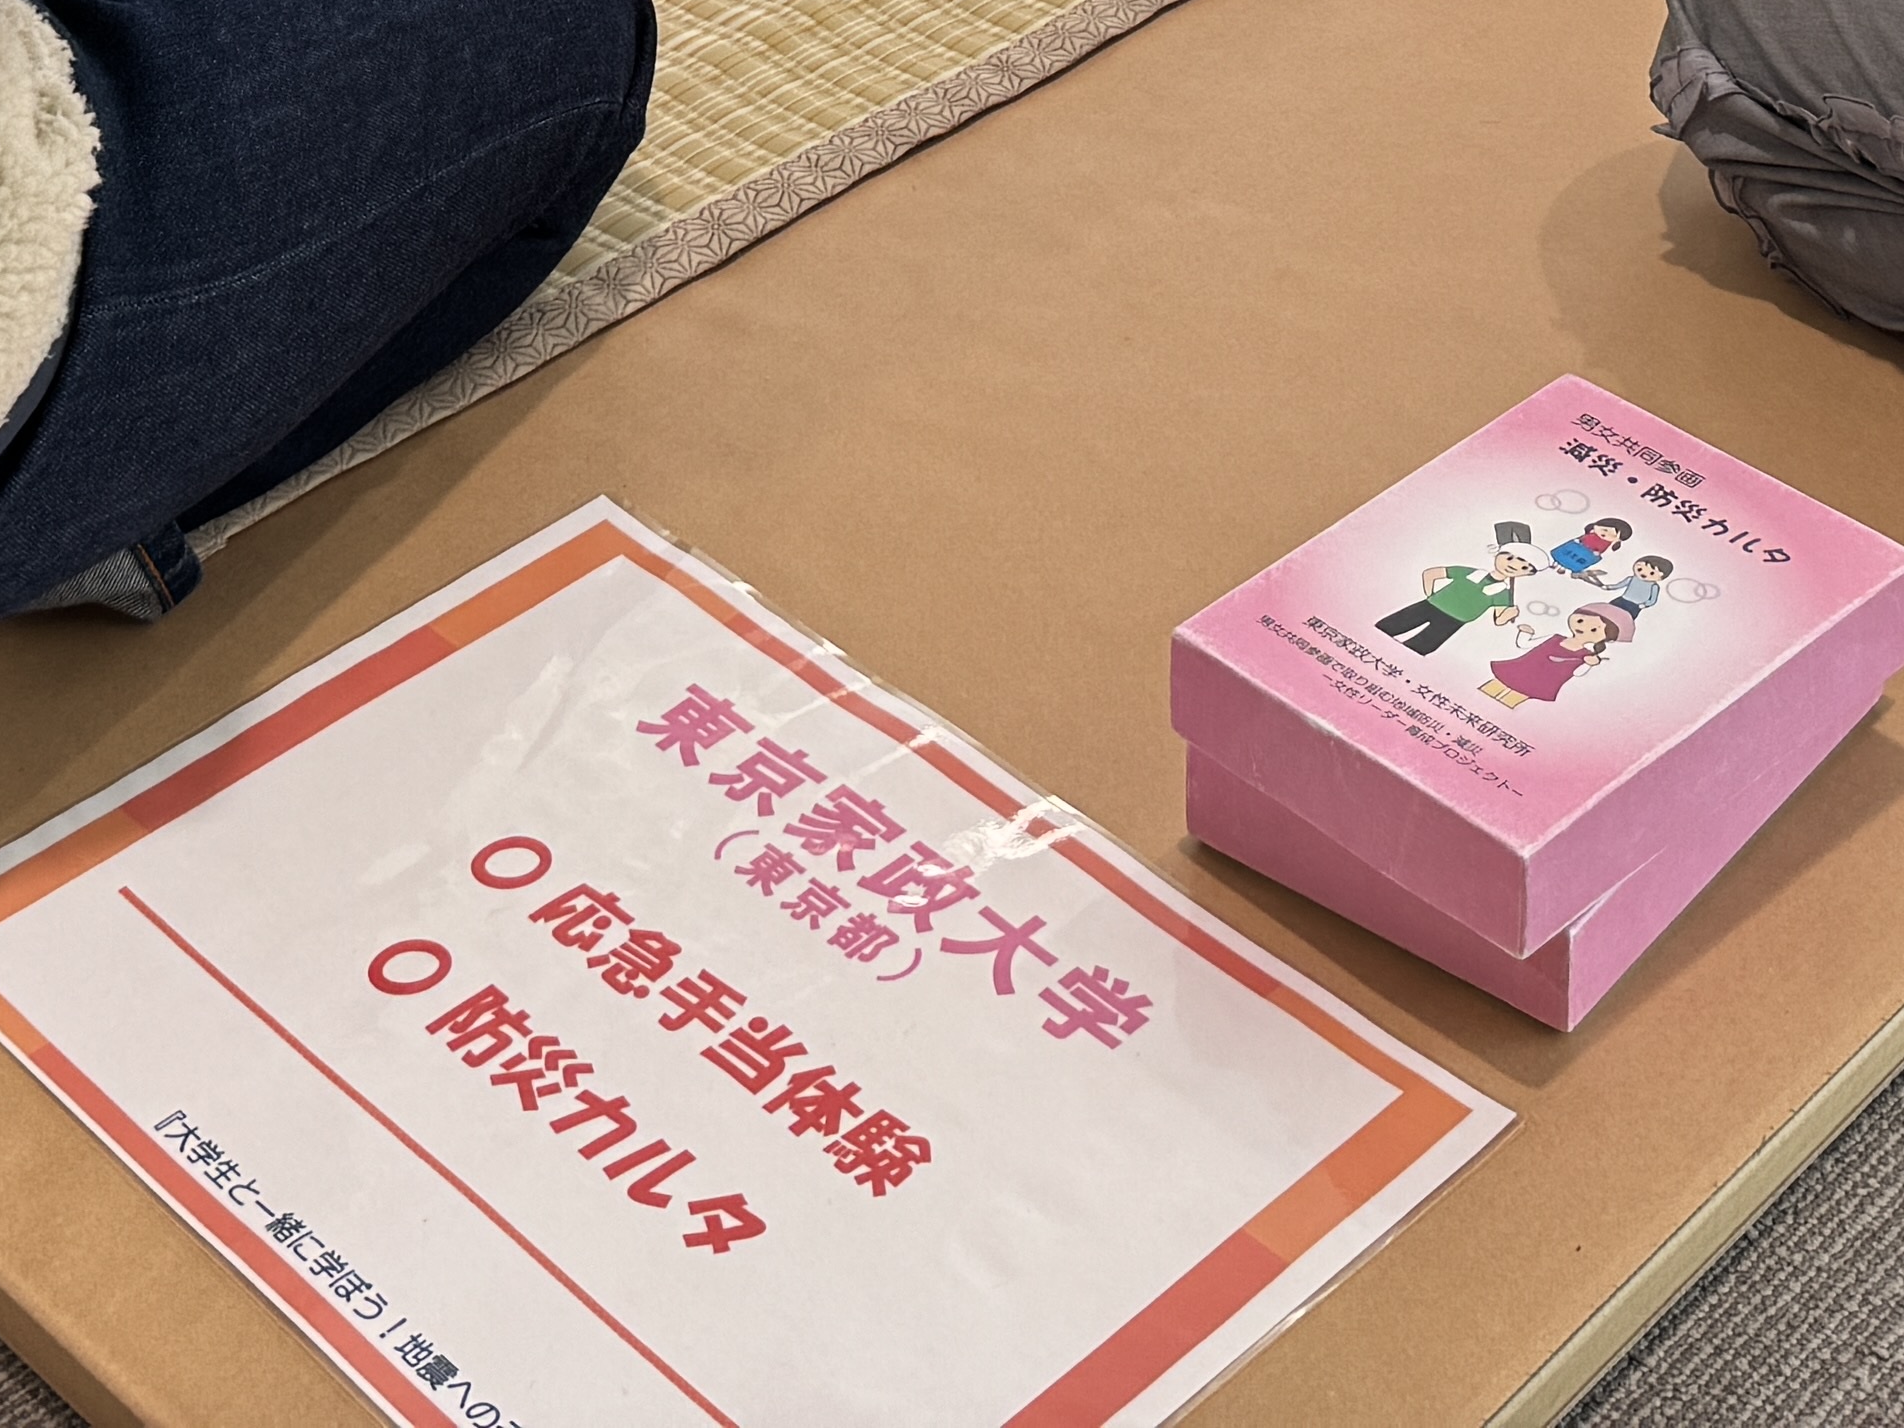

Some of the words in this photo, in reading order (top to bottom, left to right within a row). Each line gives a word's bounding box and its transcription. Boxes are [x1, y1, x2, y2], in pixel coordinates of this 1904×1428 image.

[1559, 437, 1792, 565] 減災・防災カルタ
[1570, 413, 1707, 489] 男女共同参画
[1302, 615, 1536, 758] 東京家政大学・女性未来研究所
[634, 681, 1162, 1055] 東京家政大学
[153, 1109, 527, 1428] 『大学生と一緒に学ぼう！地震への
